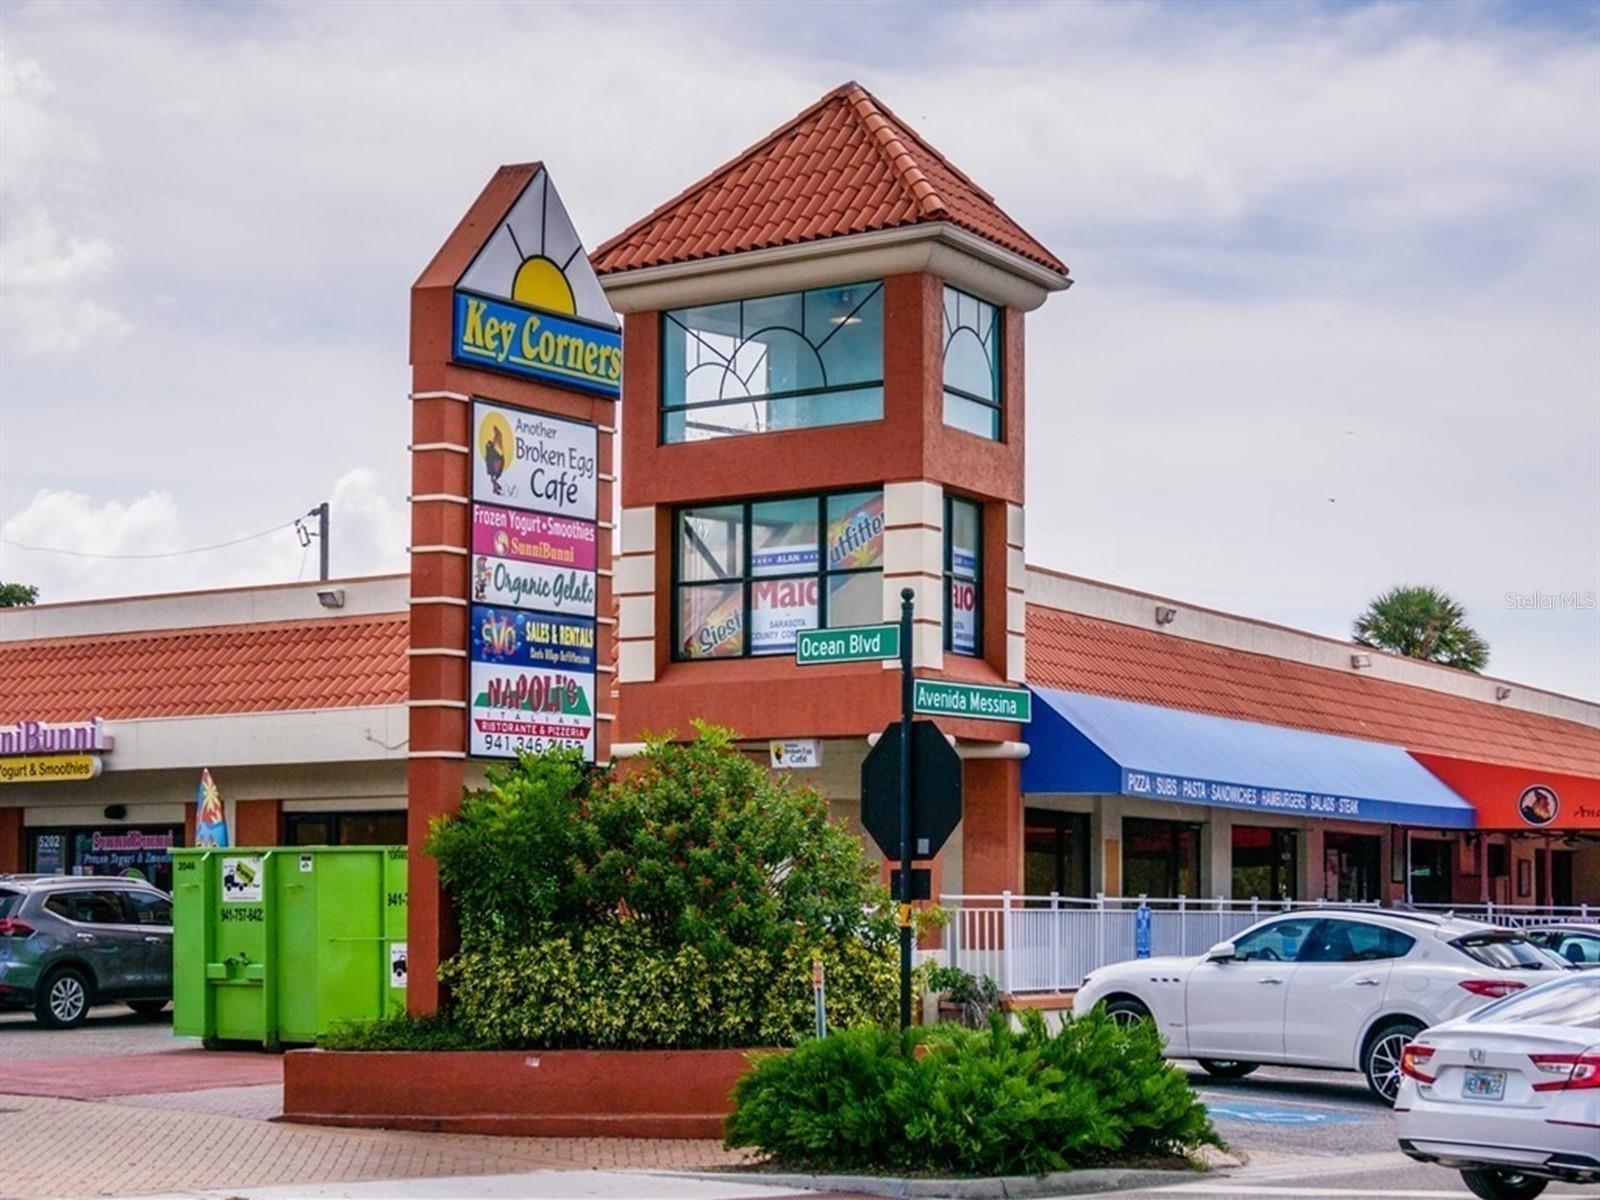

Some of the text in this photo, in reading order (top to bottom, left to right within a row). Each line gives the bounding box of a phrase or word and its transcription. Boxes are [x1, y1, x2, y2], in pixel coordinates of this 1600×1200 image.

[463, 299, 621, 380] Key Corners
[515, 418, 557, 439] Another
[516, 437, 594, 479] Broken Egg
[530, 468, 578, 507] Café
[473, 504, 507, 528] Frozen
[547, 517, 595, 541] Smoothies
[511, 538, 574, 562] SunniBunni
[777, 554, 800, 563] ALAN
[494, 562, 593, 606] Organic Gelato
[526, 621, 594, 648] SALES & RENTALS
[770, 619, 806, 628] SARASOTA
[801, 634, 880, 657] Ocean Blvd
[917, 687, 1016, 714] Avenida Messina
[481, 721, 585, 738] RISTORANTE & PIZZERIA
[486, 712, 580, 724] ITALIAN
[0, 717, 97, 753] niBunni
[29, 763, 36, 776] &
[40, 761, 90, 776] Smoothies
[1128, 773, 1359, 815] PIZZA SUBS PASTA SANDWICHES HAMBURGERS SALADS STEAK
[39, 835, 60, 848] 5202
